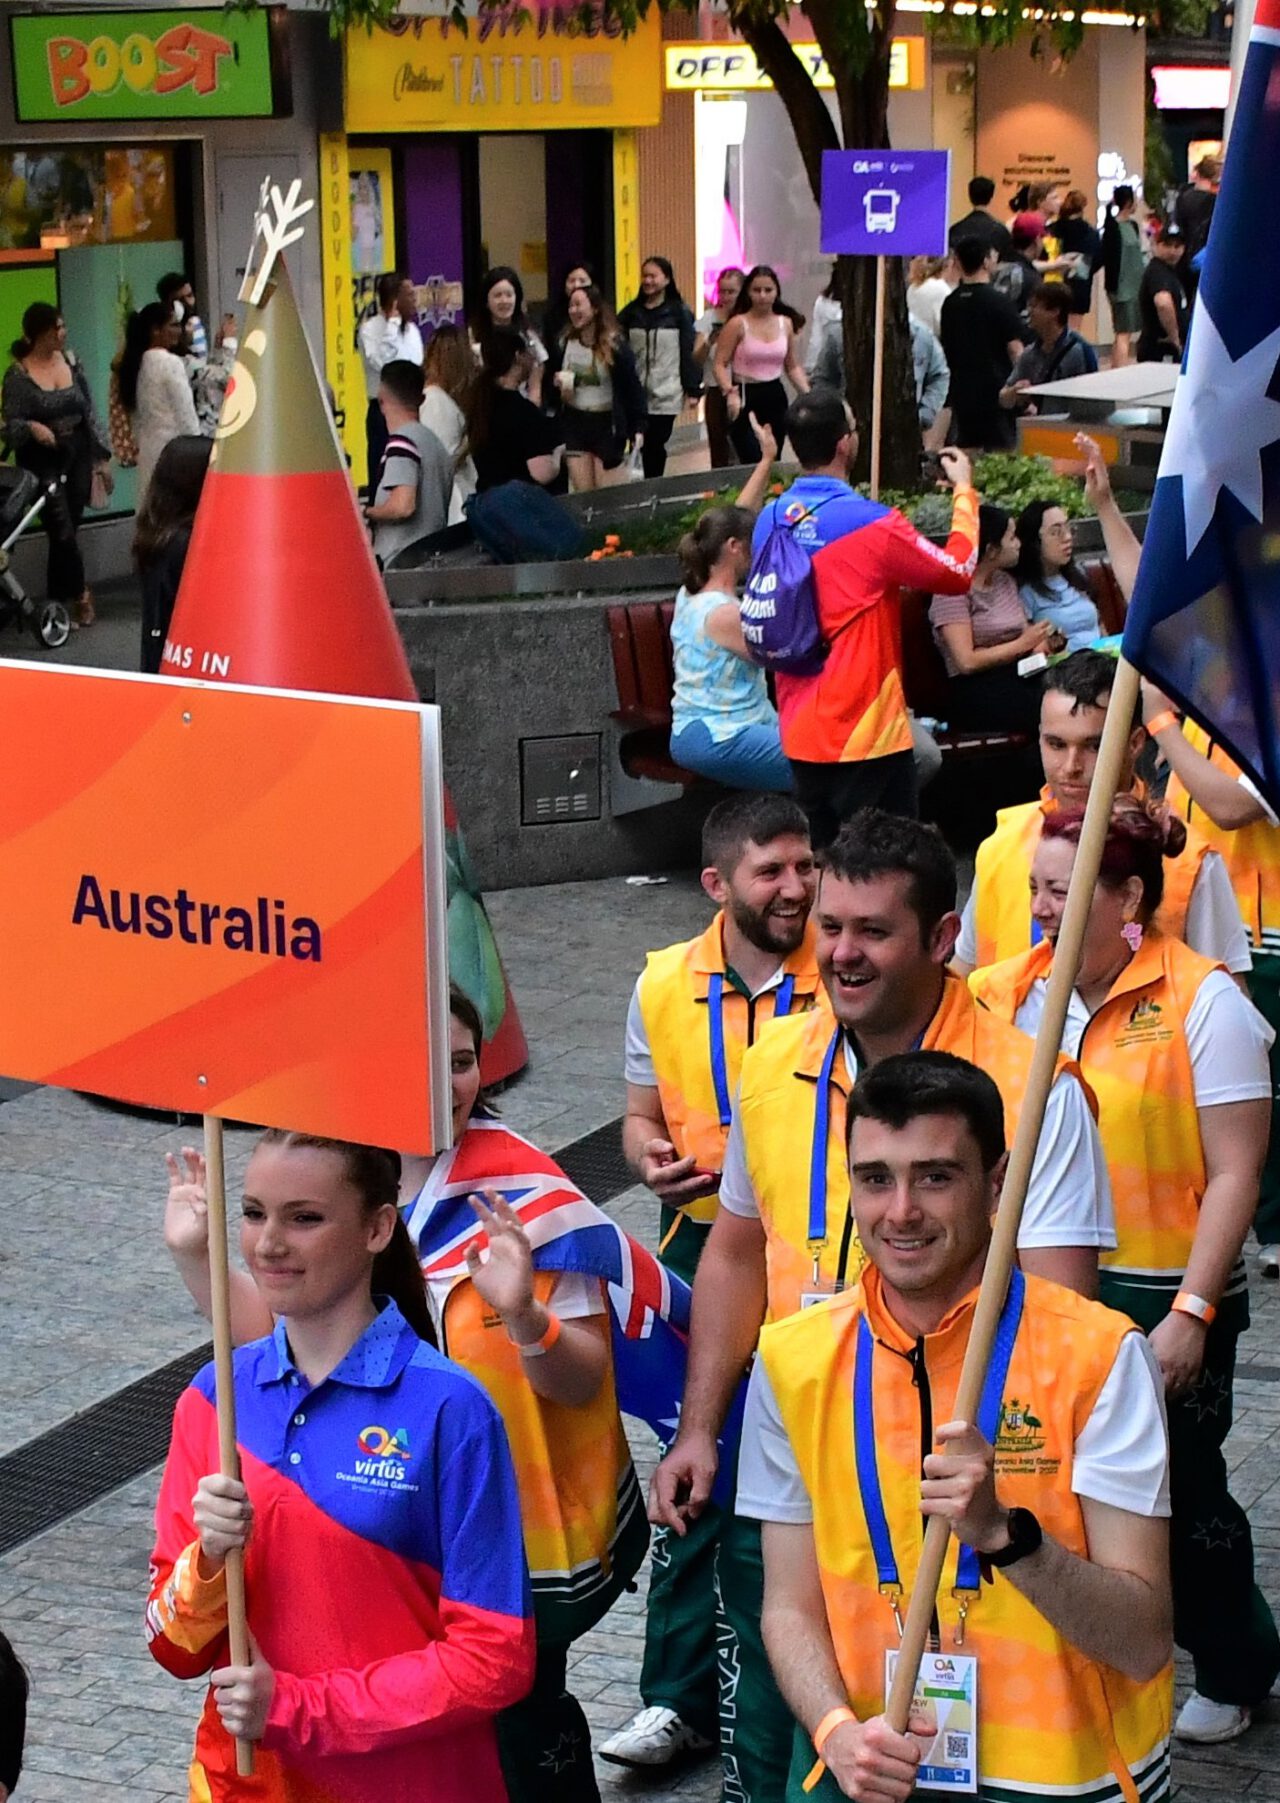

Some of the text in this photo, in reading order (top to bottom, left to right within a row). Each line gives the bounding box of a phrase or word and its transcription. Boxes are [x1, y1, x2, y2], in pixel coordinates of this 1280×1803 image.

[46, 23, 234, 106] BOOST
[676, 56, 744, 78] OFF
[450, 54, 563, 105] TATTOO
[201, 651, 230, 677] IN
[72, 874, 322, 962] Australia
[355, 1458, 406, 1480] virtus
[335, 1472, 420, 1492] Oceania Asia Games
[934, 1659, 955, 1672] OA
